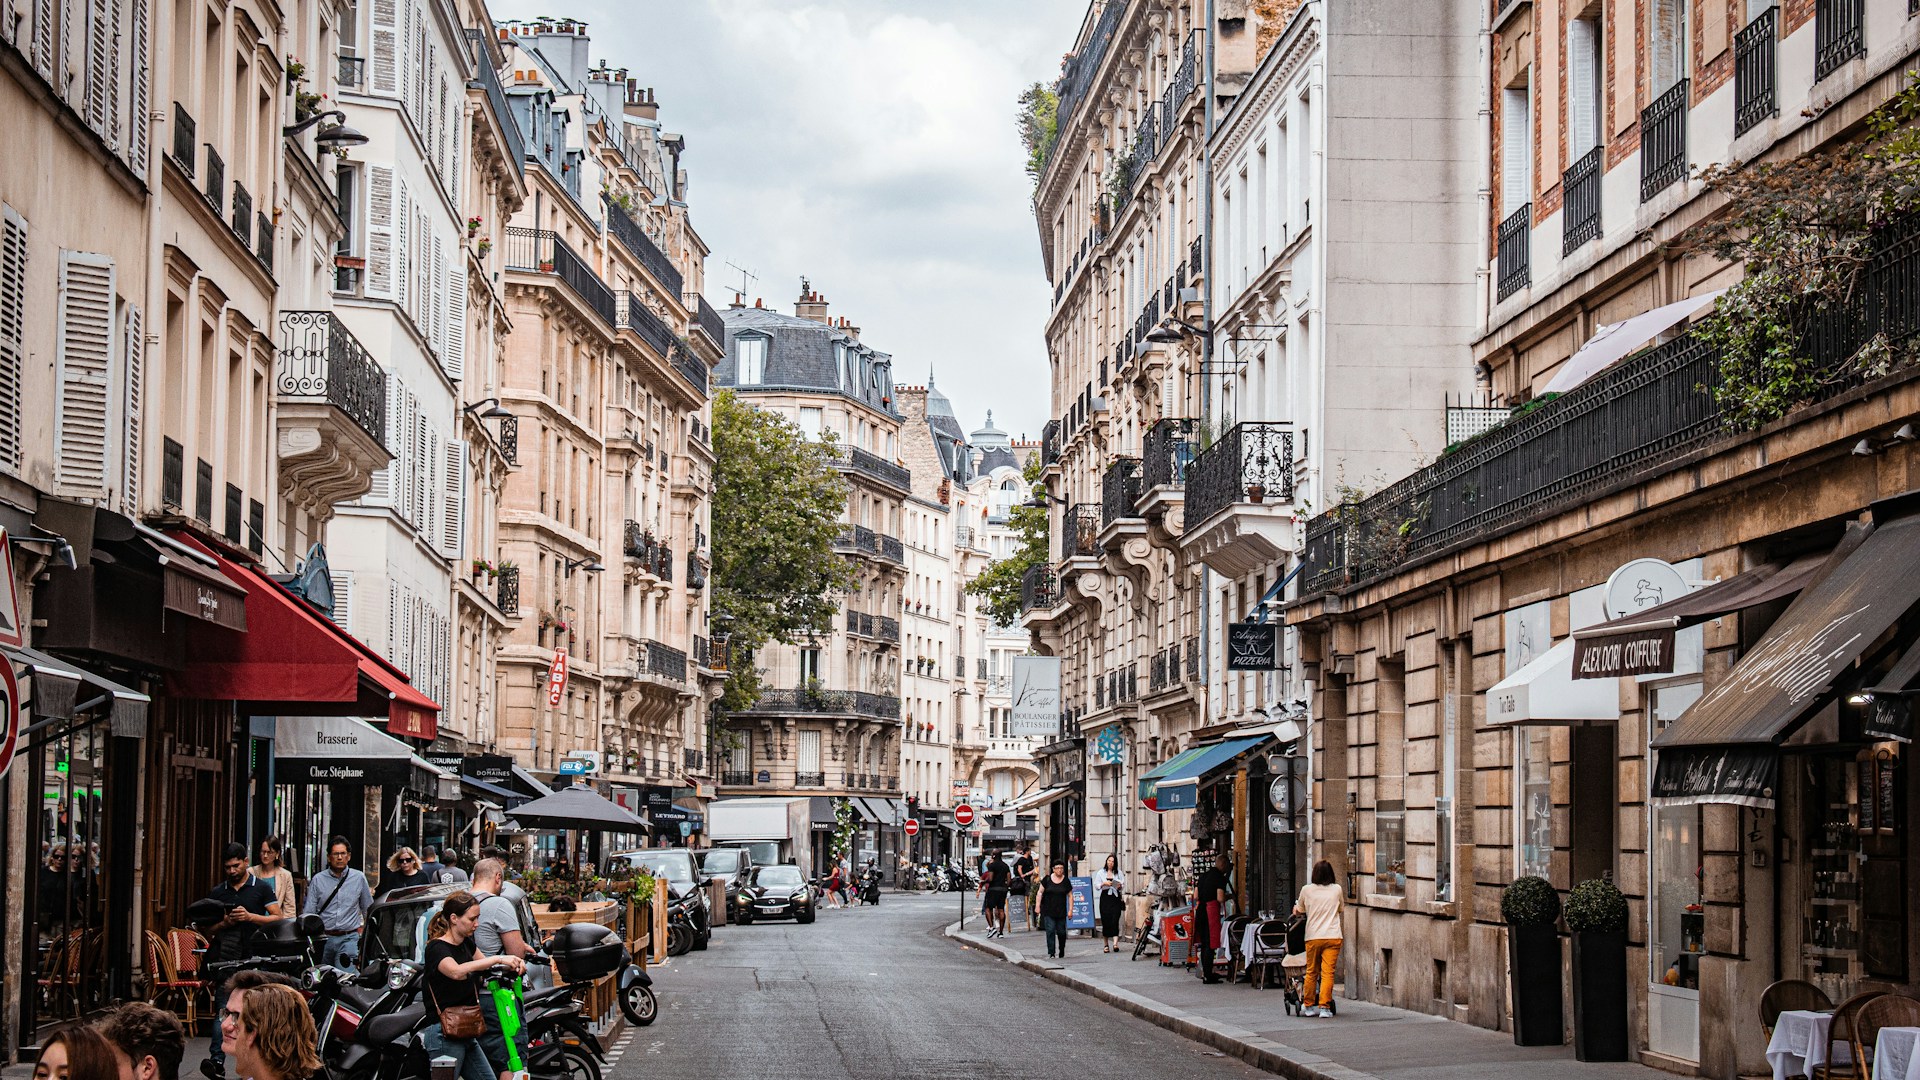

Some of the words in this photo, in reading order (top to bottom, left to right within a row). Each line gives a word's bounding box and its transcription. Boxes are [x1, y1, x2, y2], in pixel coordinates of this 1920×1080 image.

[1232, 656, 1272, 666] PIZZERIA
[1580, 643, 1600, 673] ALEX
[1601, 641, 1622, 672] DORI
[1624, 638, 1663, 671] COIFFURE
[550, 652, 565, 703] TABAC
[1014, 712, 1057, 720] BOULANGER
[1014, 720, 1057, 729] PÂTISSIER
[317, 731, 358, 745] Brasserie
[309, 765, 328, 778] Chez
[329, 765, 364, 780] Stéphane
